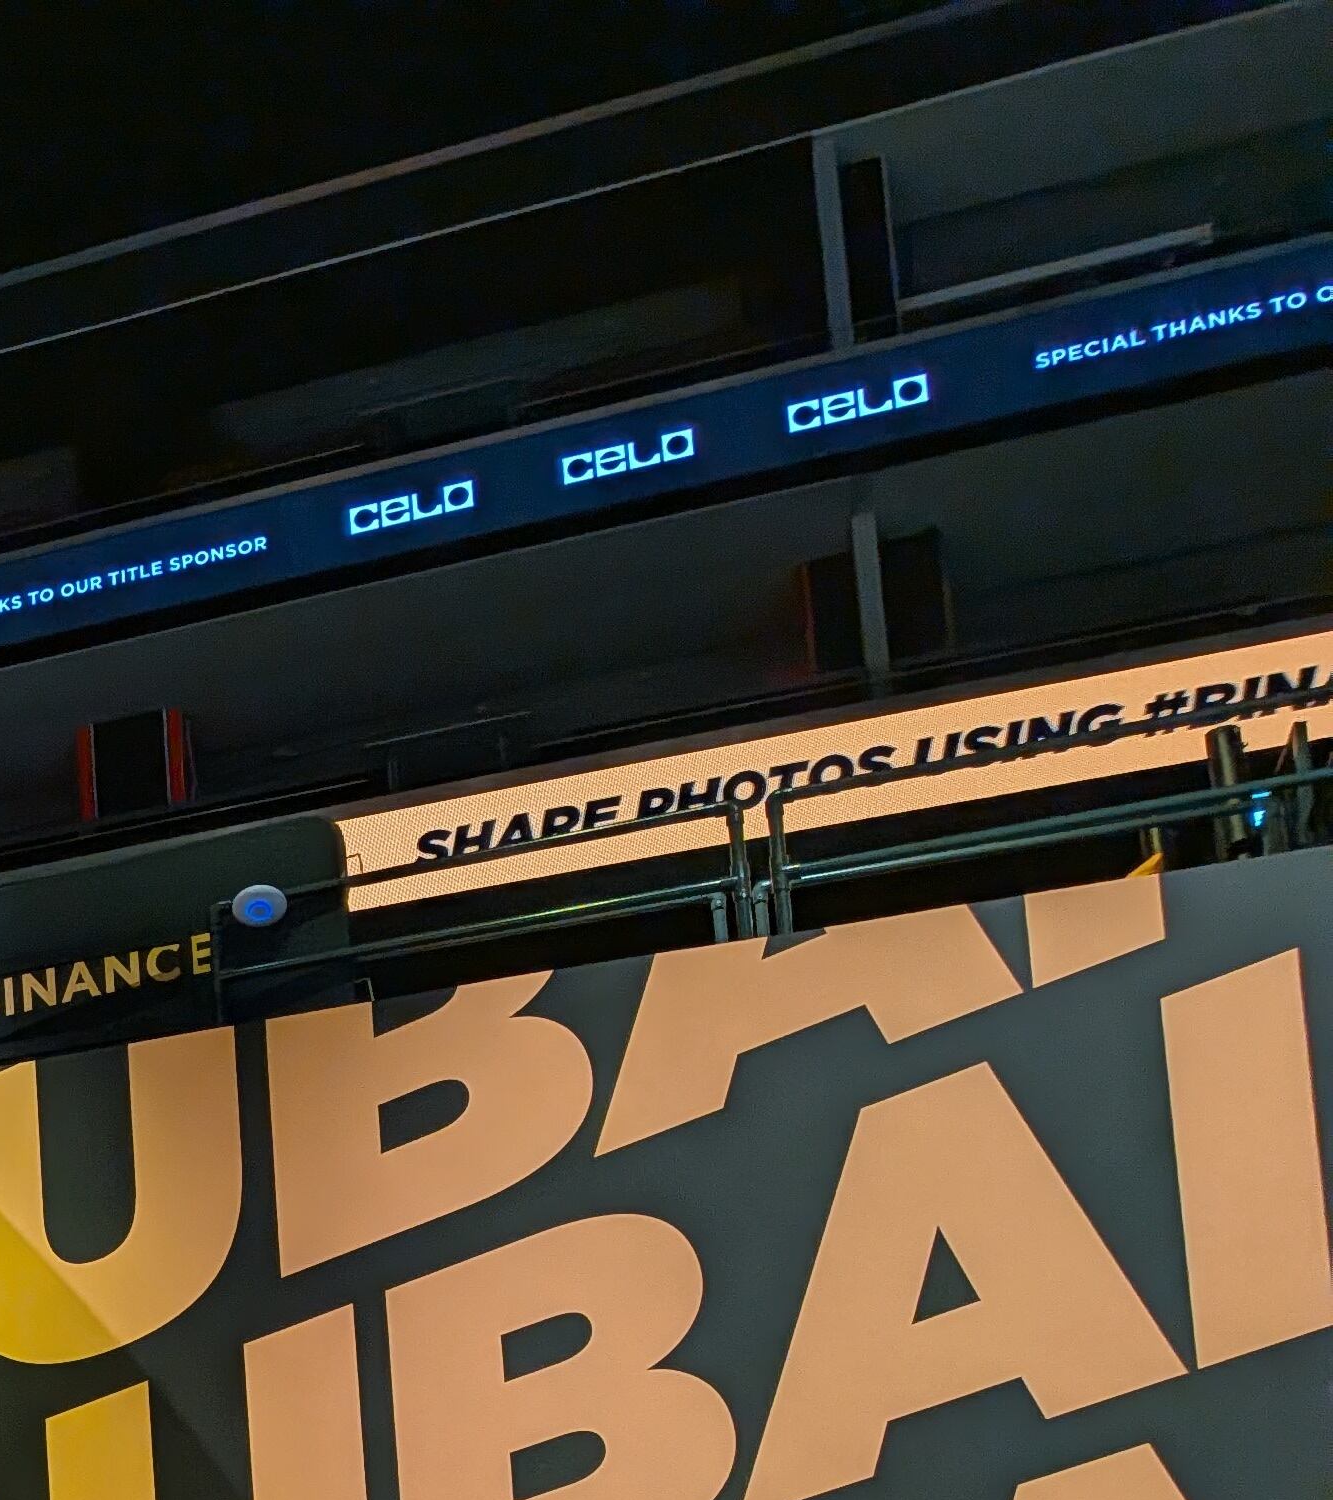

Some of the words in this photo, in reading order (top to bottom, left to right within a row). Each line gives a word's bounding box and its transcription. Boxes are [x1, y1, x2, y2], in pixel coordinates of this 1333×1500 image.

[1035, 329, 1146, 369] SPECIAL
[1151, 301, 1263, 341] THANKS
[1269, 291, 1307, 315] TO
[28, 588, 54, 606] TO
[60, 575, 103, 598] OUR
[108, 560, 163, 587] TITLE
[169, 536, 268, 572] SPONSOR
